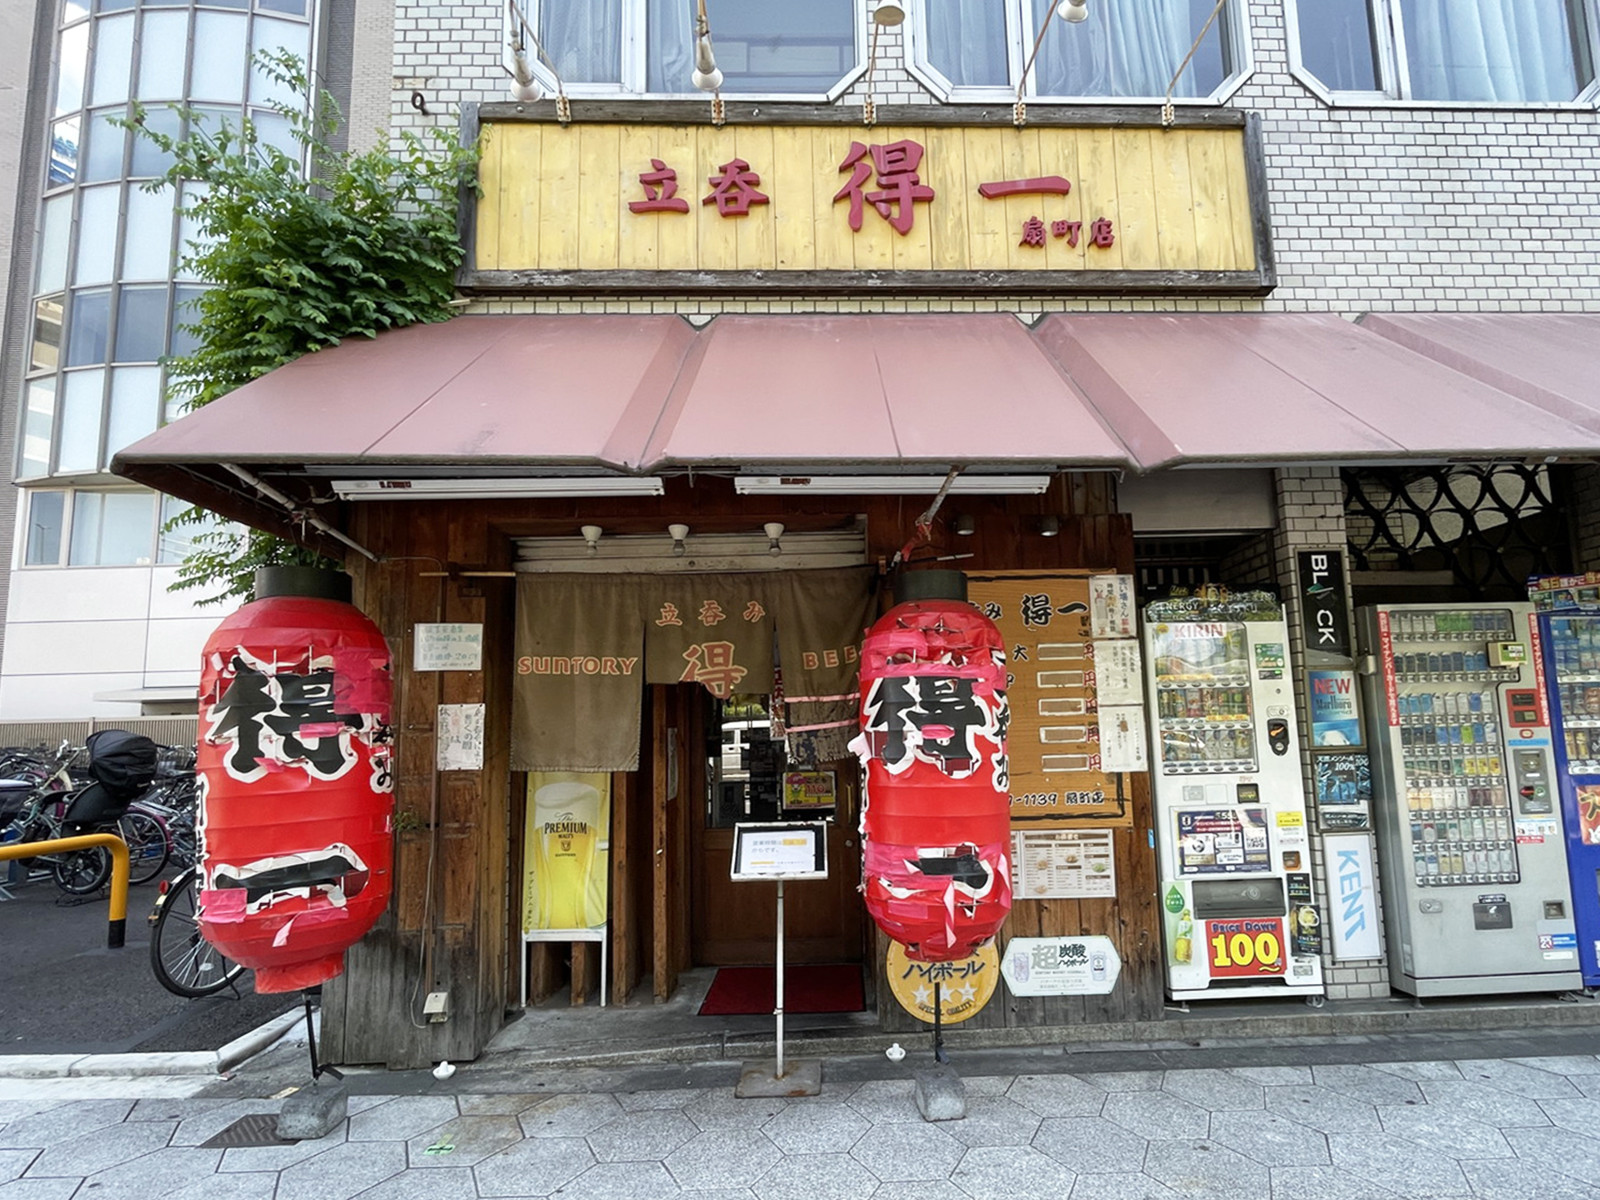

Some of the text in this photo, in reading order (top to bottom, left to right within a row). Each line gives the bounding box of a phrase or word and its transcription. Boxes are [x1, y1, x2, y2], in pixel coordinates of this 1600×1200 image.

[1019, 216, 1116, 249] 扇町店
[656, 600, 765, 626] 立呑み
[1021, 593, 1089, 626] 得一
[1174, 623, 1224, 638] KIRIN
[802, 645, 862, 670] BEE
[1014, 645, 1028, 660] 大
[518, 656, 638, 675] SUNTORY
[1084, 670, 1097, 688] 円
[1313, 678, 1351, 695] NEW
[544, 822, 587, 834] PREMIUM
[1337, 850, 1365, 941] KENT
[1031, 944, 1087, 969] 超 炭酸
[1212, 932, 1279, 967] 100
[902, 961, 985, 984] ハイボール
